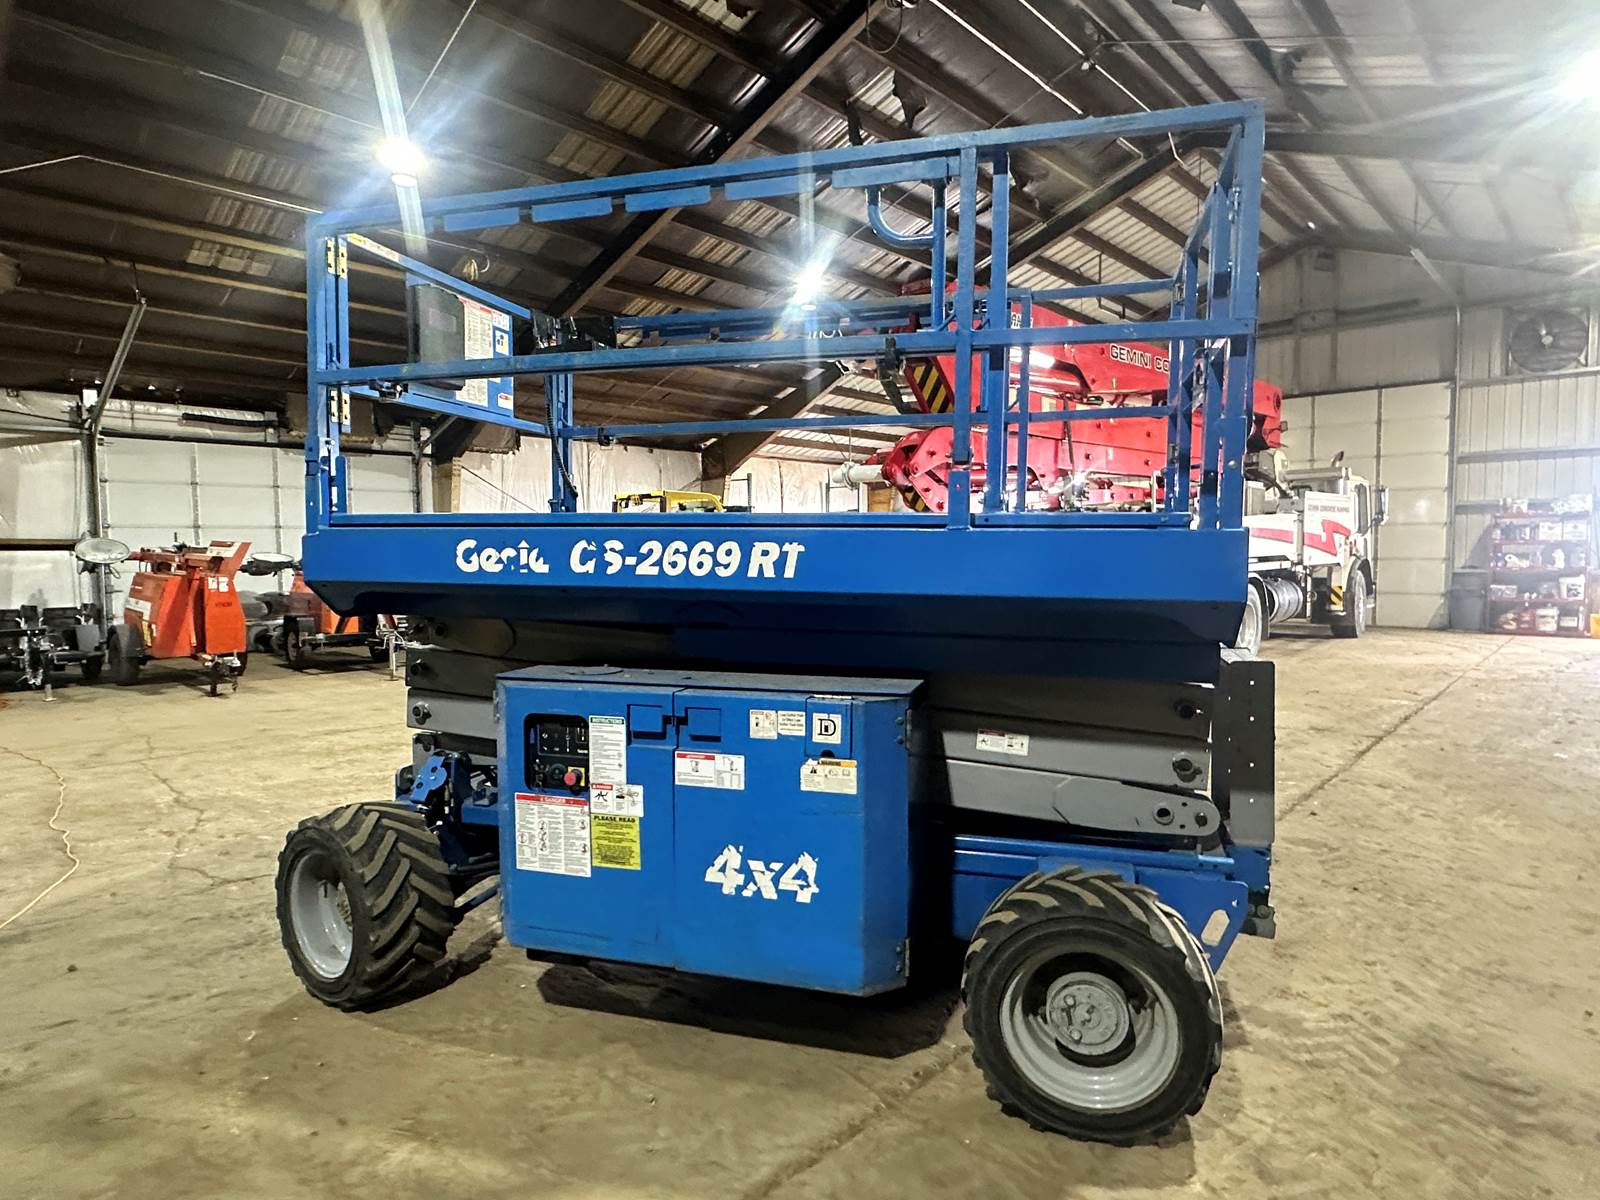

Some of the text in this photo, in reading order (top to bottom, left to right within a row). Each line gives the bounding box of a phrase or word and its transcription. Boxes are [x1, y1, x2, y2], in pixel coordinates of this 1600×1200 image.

[1110, 344, 1151, 369] GEMINI
[569, 539, 742, 577] GS-2669
[747, 542, 806, 578] RT
[817, 718, 836, 736] D
[705, 844, 819, 903] 4x4
